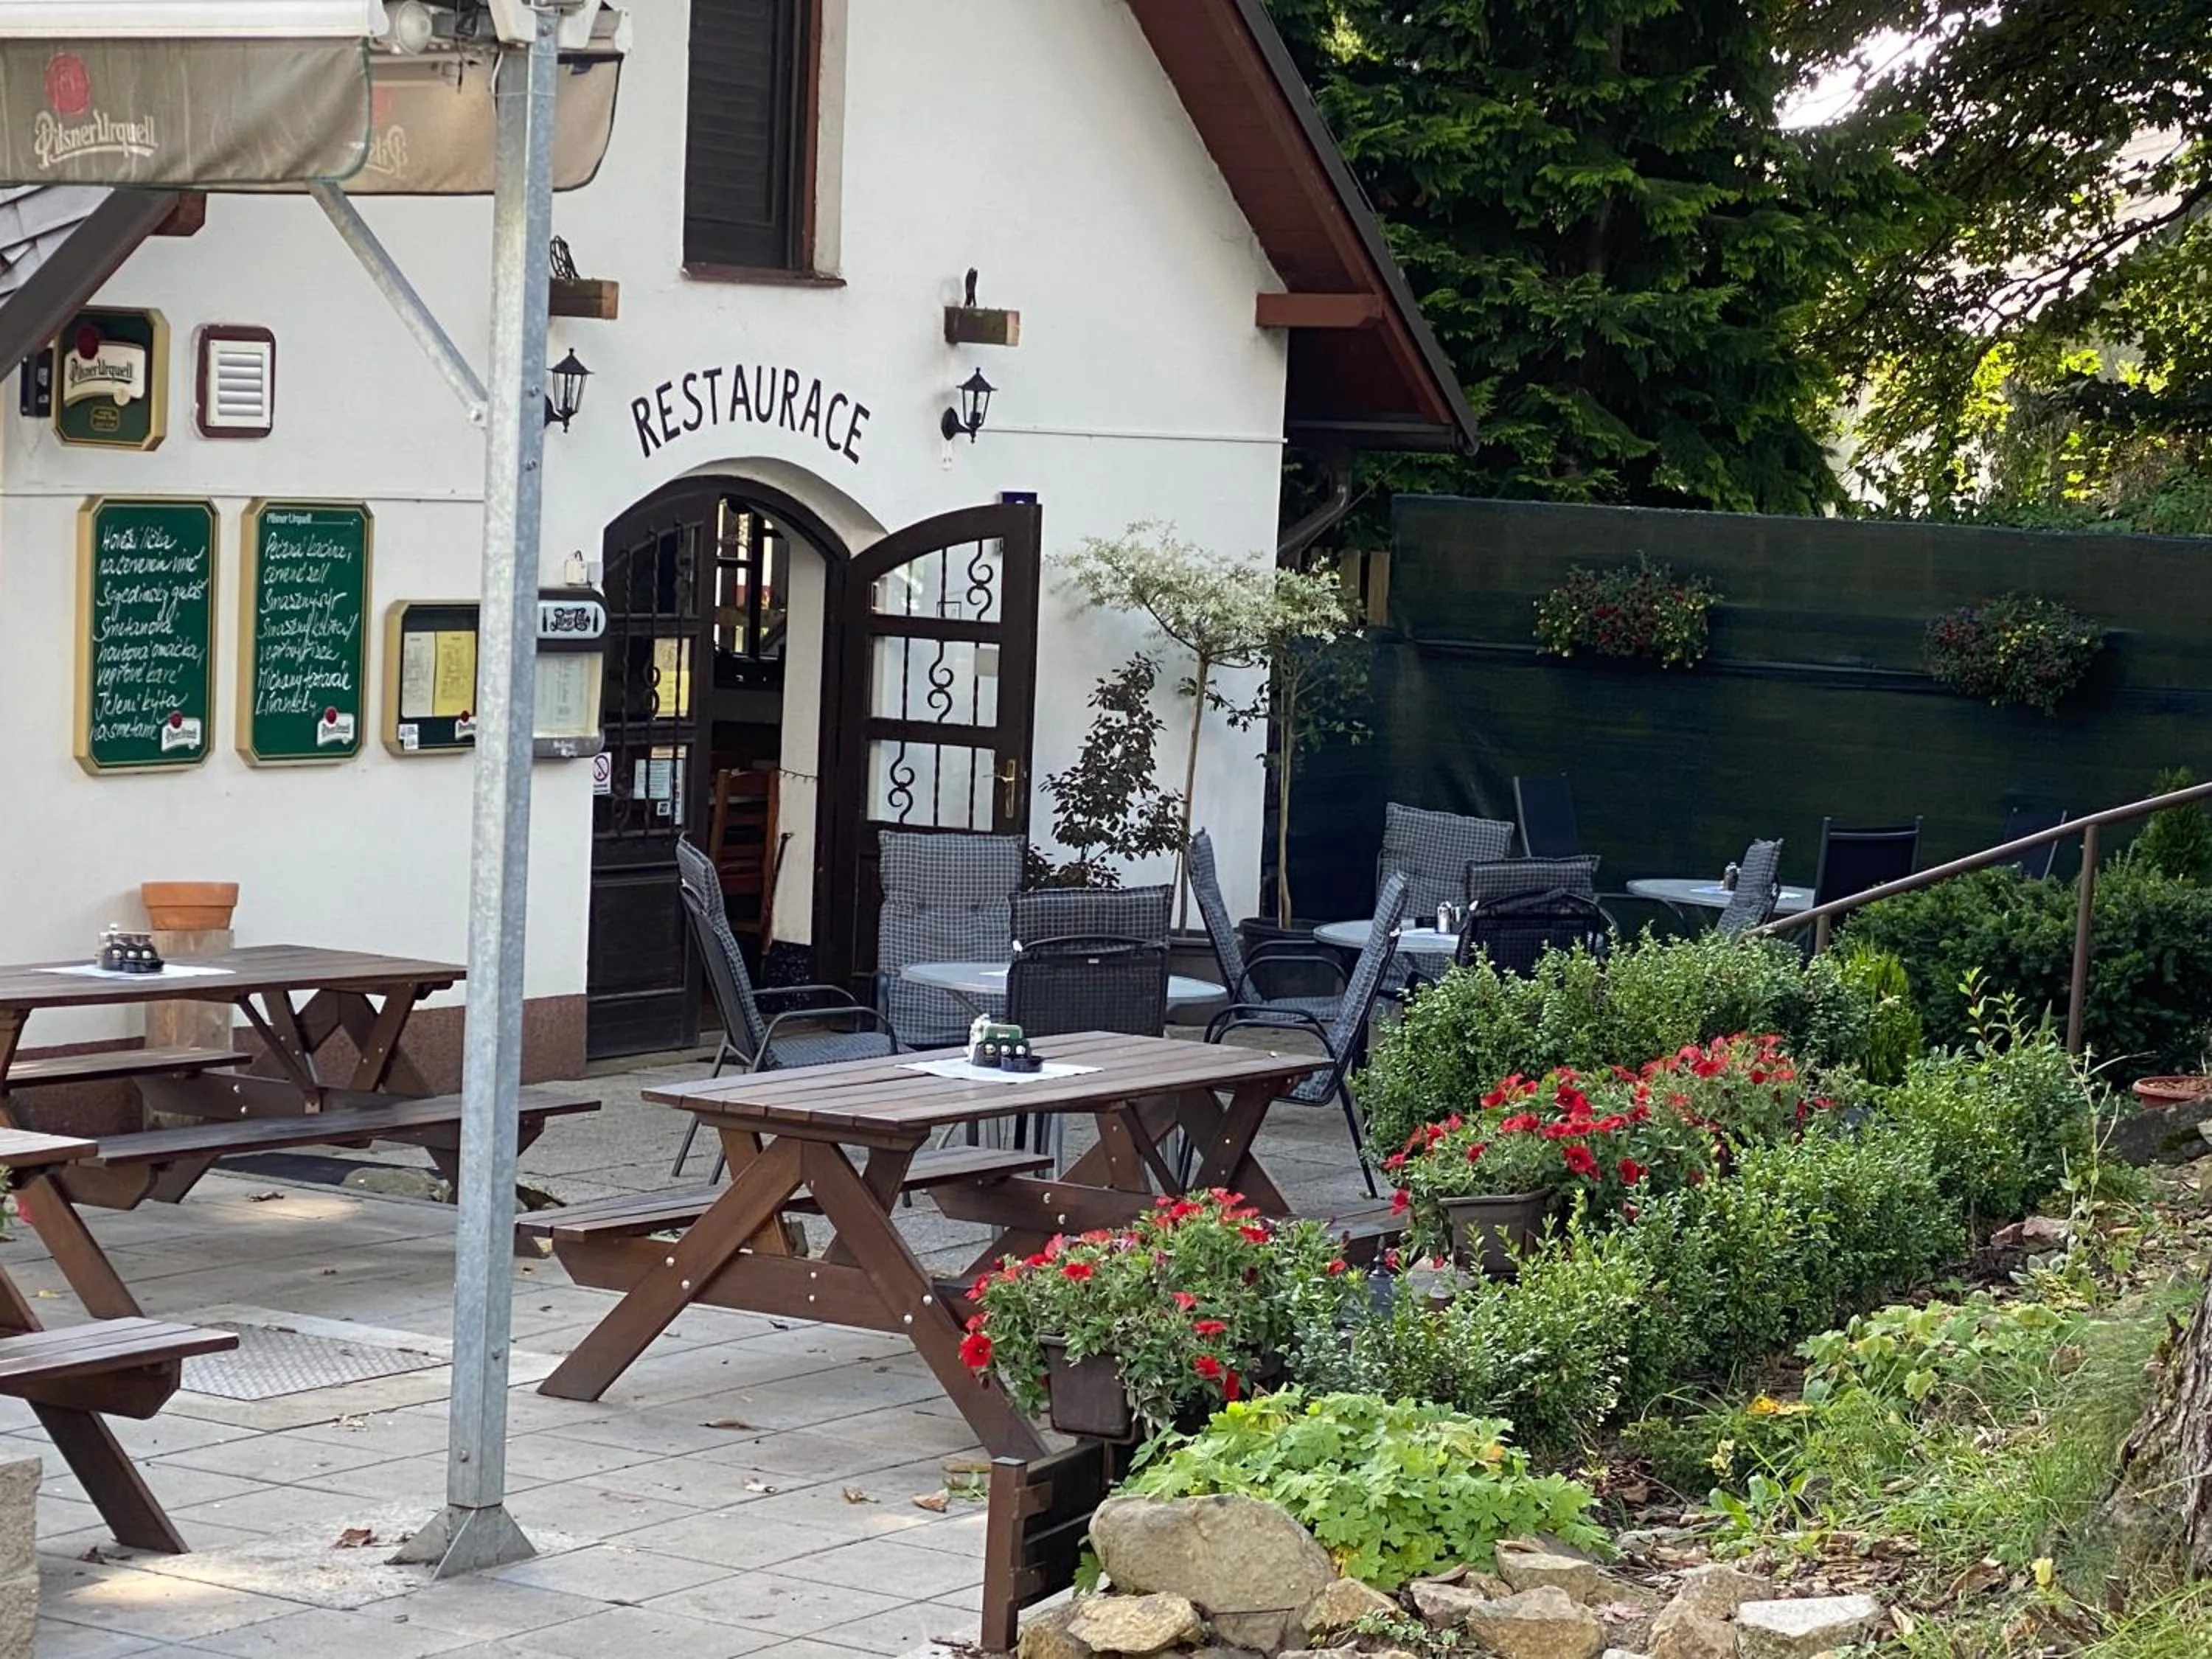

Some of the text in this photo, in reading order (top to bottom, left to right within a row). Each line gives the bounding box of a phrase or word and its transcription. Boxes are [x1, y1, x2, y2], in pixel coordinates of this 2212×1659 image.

[35, 108, 159, 170] Pilsner Urquell
[631, 364, 871, 465] RESTAURACE
